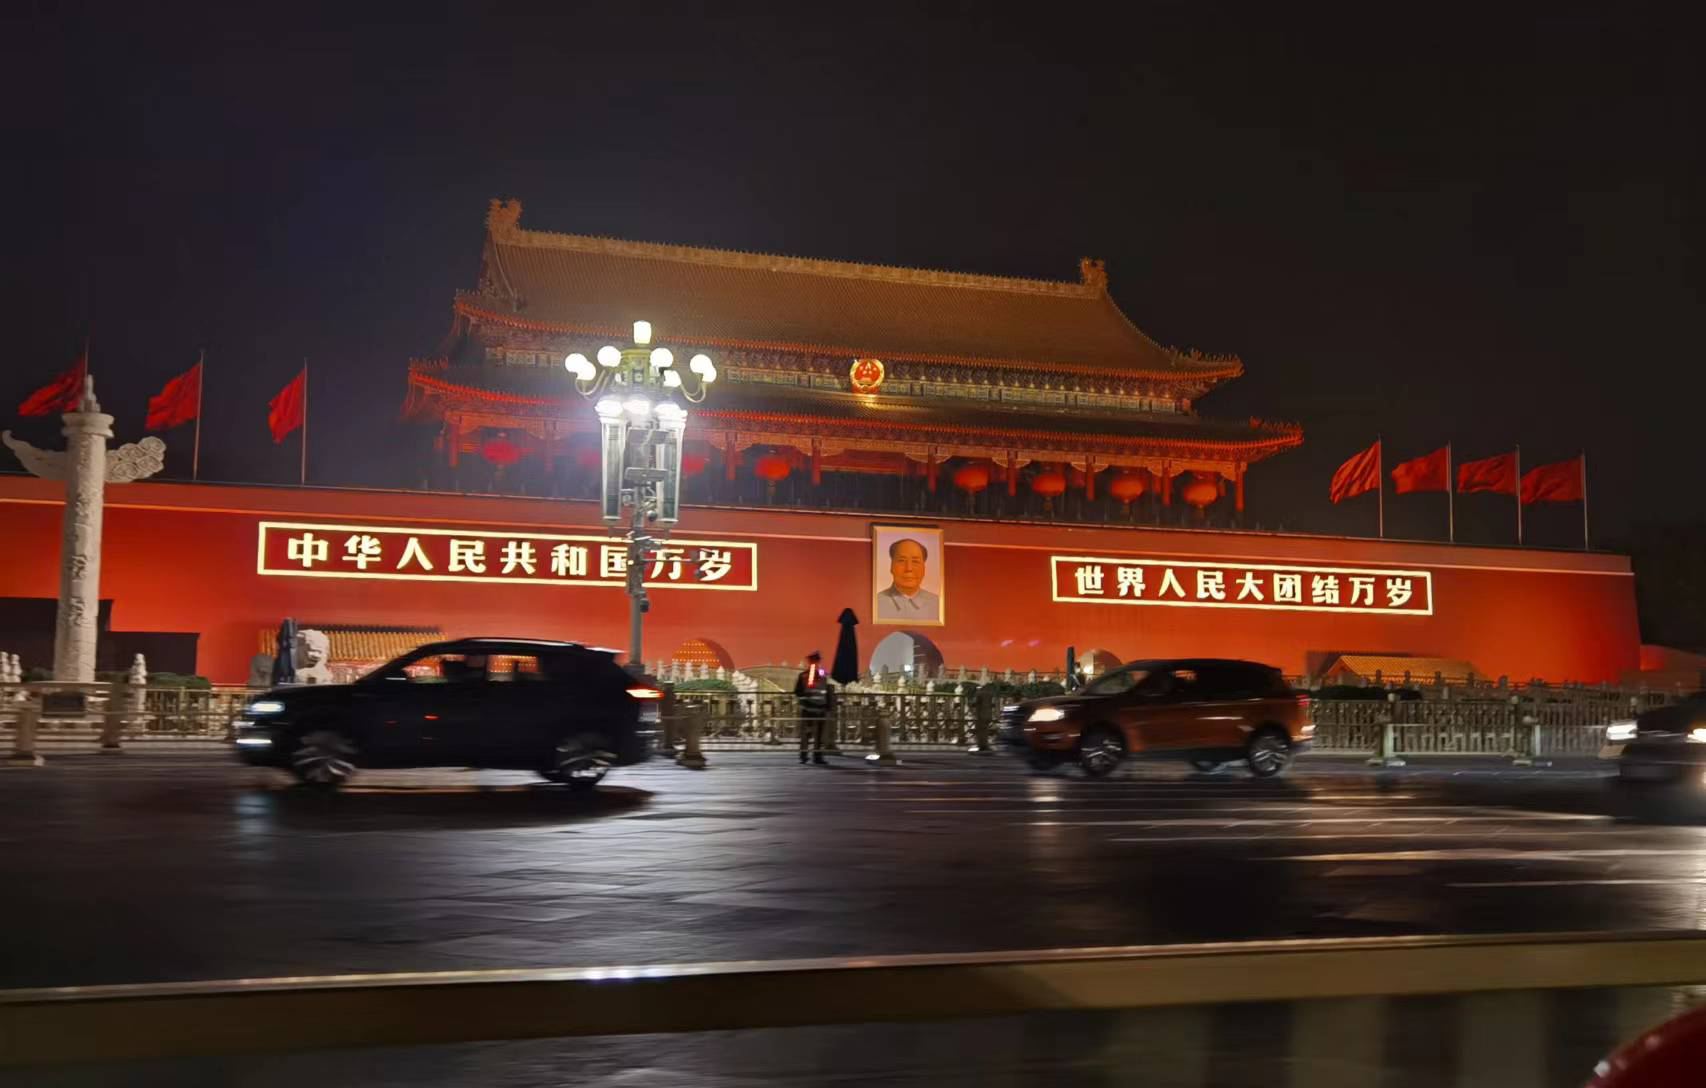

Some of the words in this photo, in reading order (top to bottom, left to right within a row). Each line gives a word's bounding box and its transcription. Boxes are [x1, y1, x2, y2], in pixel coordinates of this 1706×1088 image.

[287, 532, 732, 582] 中华人民共和国万岁
[1075, 566, 1413, 607] 世界人民大团结万岁
